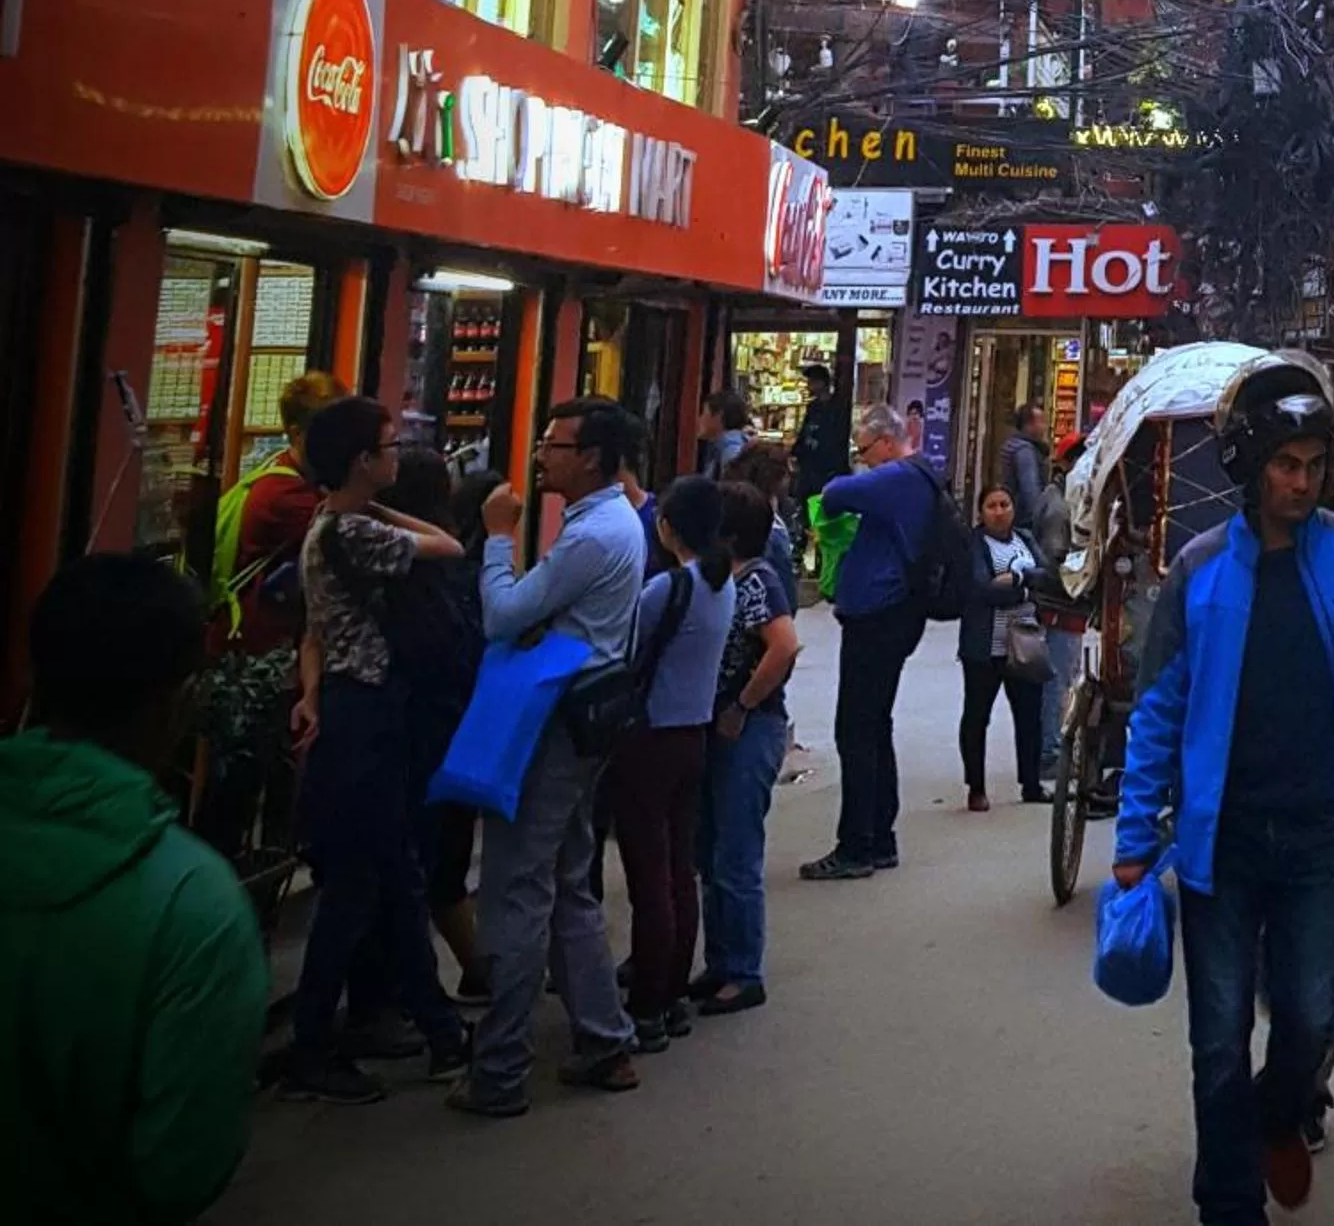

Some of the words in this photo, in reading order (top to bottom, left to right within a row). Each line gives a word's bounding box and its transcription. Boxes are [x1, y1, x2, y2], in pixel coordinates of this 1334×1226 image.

[795, 118, 918, 161] chen
[955, 144, 1006, 160] Finest
[954, 162, 994, 178] Multi
[998, 163, 1058, 180] Cuisine
[936, 249, 1006, 277] Curry
[1029, 236, 1174, 295] Hot
[924, 276, 1016, 298] Kitchen
[920, 303, 1020, 315] Restaurant
